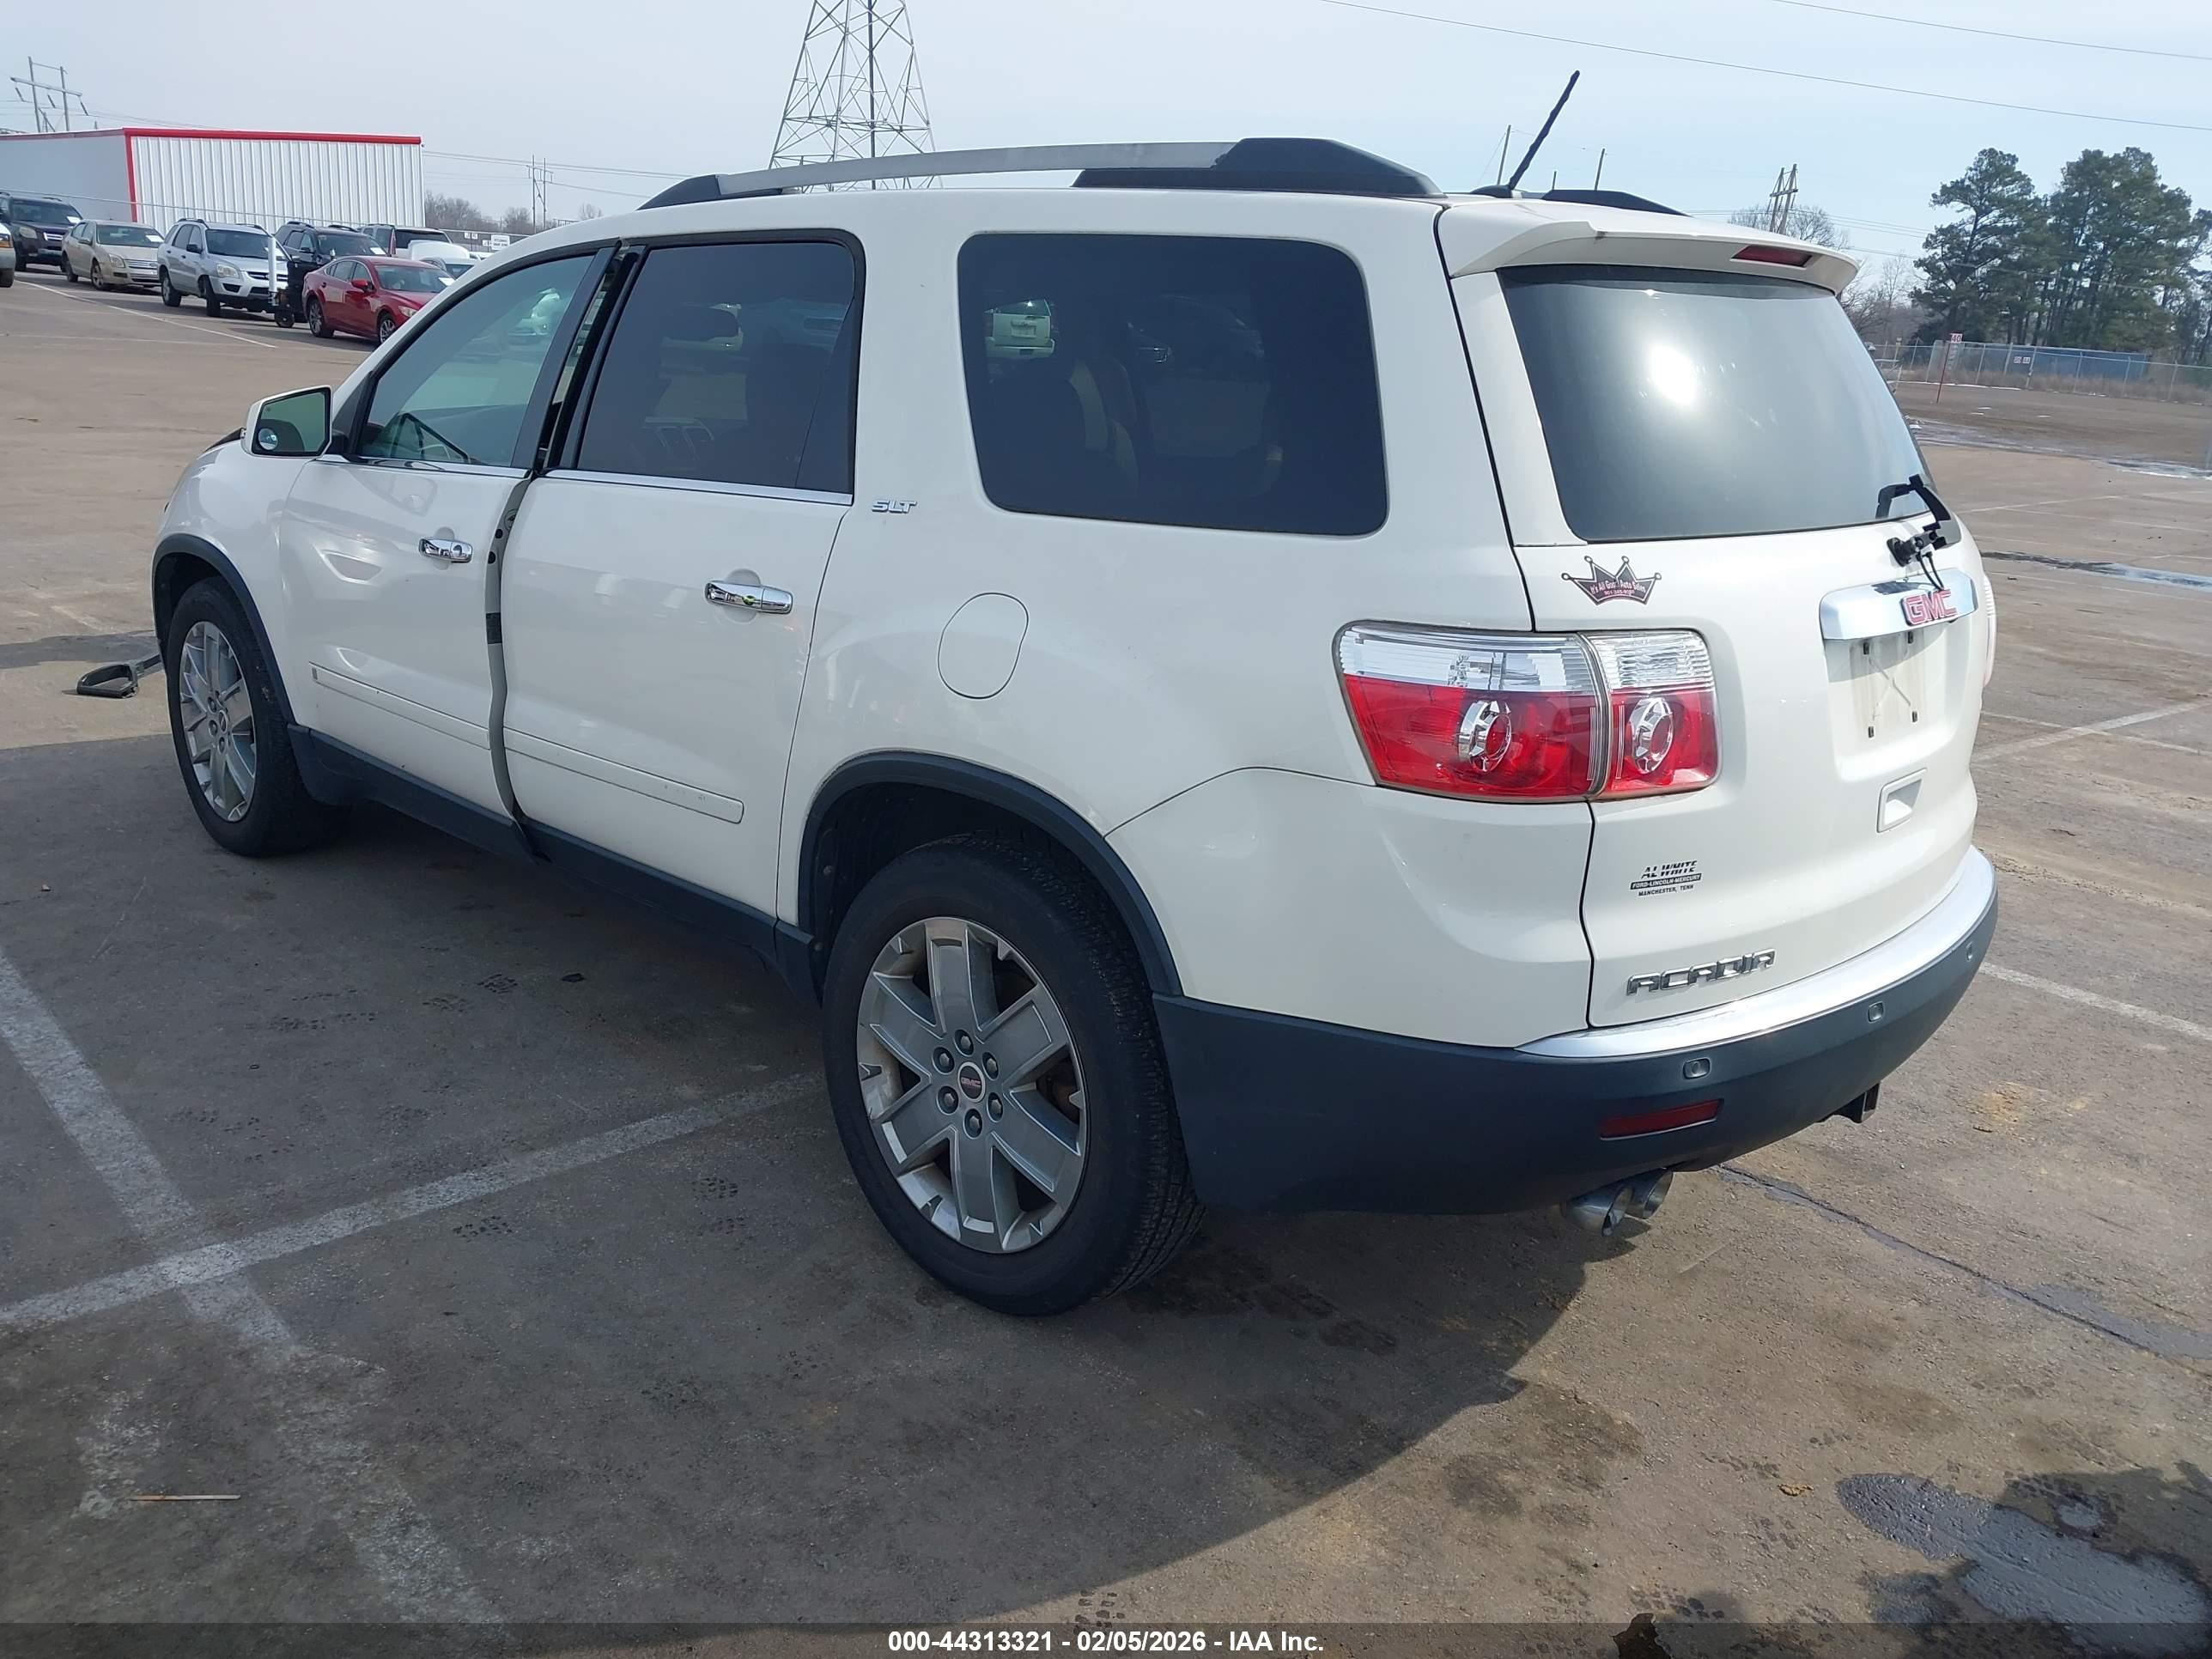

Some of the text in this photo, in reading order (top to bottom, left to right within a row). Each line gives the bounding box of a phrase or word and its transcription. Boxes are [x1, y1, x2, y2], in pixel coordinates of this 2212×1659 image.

[872, 500, 918, 514] SLT
[1905, 588, 1959, 624] GMC
[1641, 860, 1697, 878] AL WHITE
[1626, 948, 1776, 996] ACADIA
[961, 1077, 981, 1088] GMC
